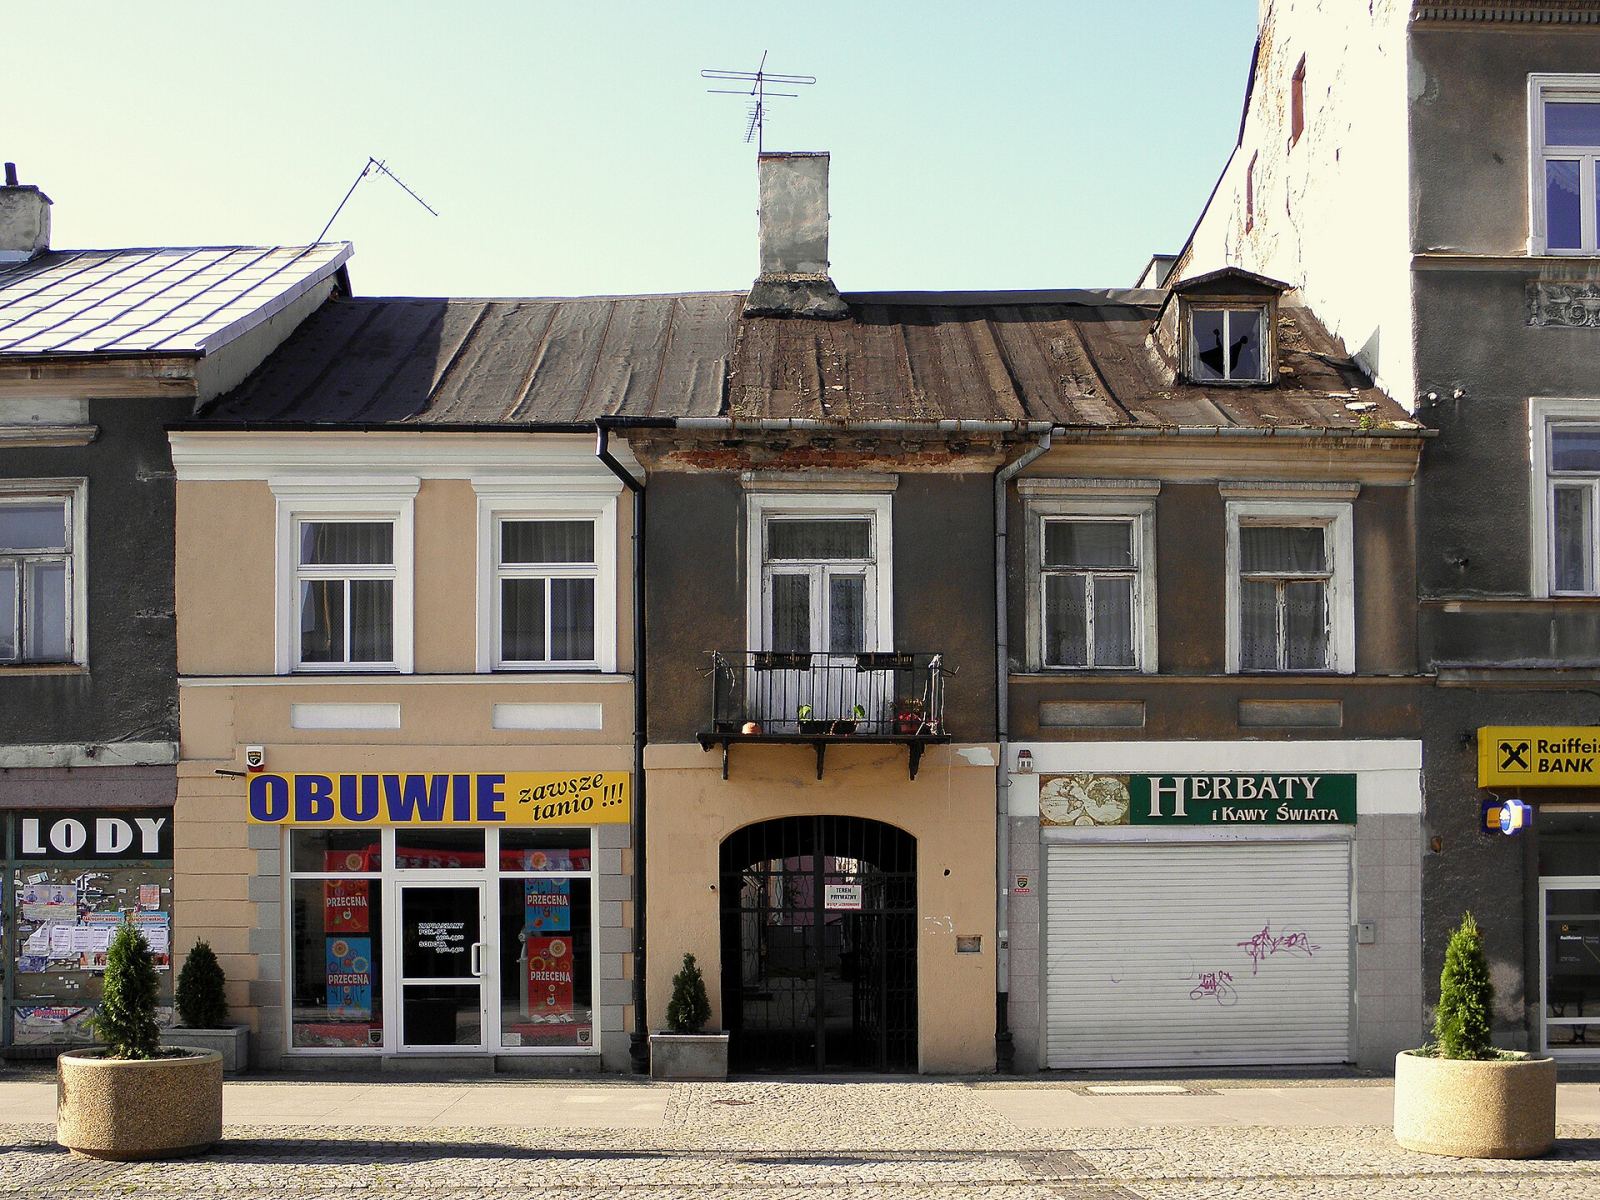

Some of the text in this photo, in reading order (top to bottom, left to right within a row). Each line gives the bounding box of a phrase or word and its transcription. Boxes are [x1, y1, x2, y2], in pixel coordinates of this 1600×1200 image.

[1538, 758, 1594, 773] BANK
[518, 773, 604, 804] zawsze
[249, 774, 506, 822] OBUWIE
[532, 782, 624, 821] tanio !!!
[1147, 776, 1320, 818] HERBATY
[1222, 806, 1267, 821] KAWY
[22, 818, 166, 853] LODY
[326, 896, 368, 907] PRZECENA
[527, 894, 568, 906] PRZECENA
[328, 973, 369, 985] PRZECENA
[530, 971, 571, 982] PRZECENA
